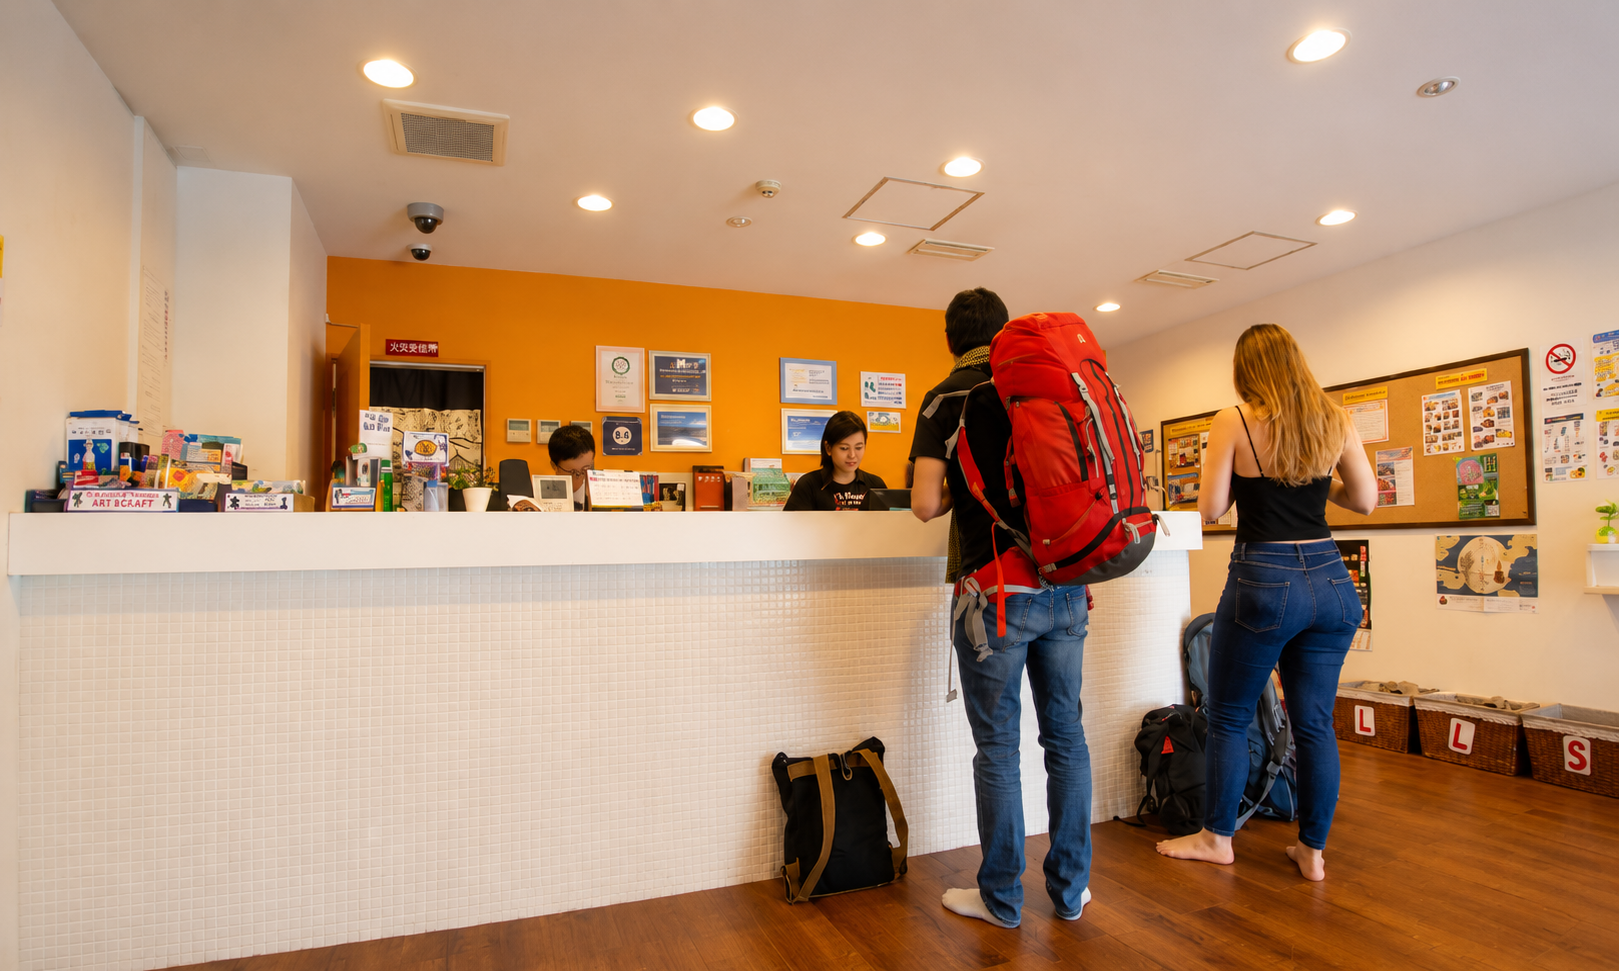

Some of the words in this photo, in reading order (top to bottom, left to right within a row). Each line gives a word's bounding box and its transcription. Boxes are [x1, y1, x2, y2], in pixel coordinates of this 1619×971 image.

[92, 499, 111, 508] ART
[1359, 708, 1372, 733] L
[1452, 722, 1468, 751] L
[1567, 740, 1588, 771] S
